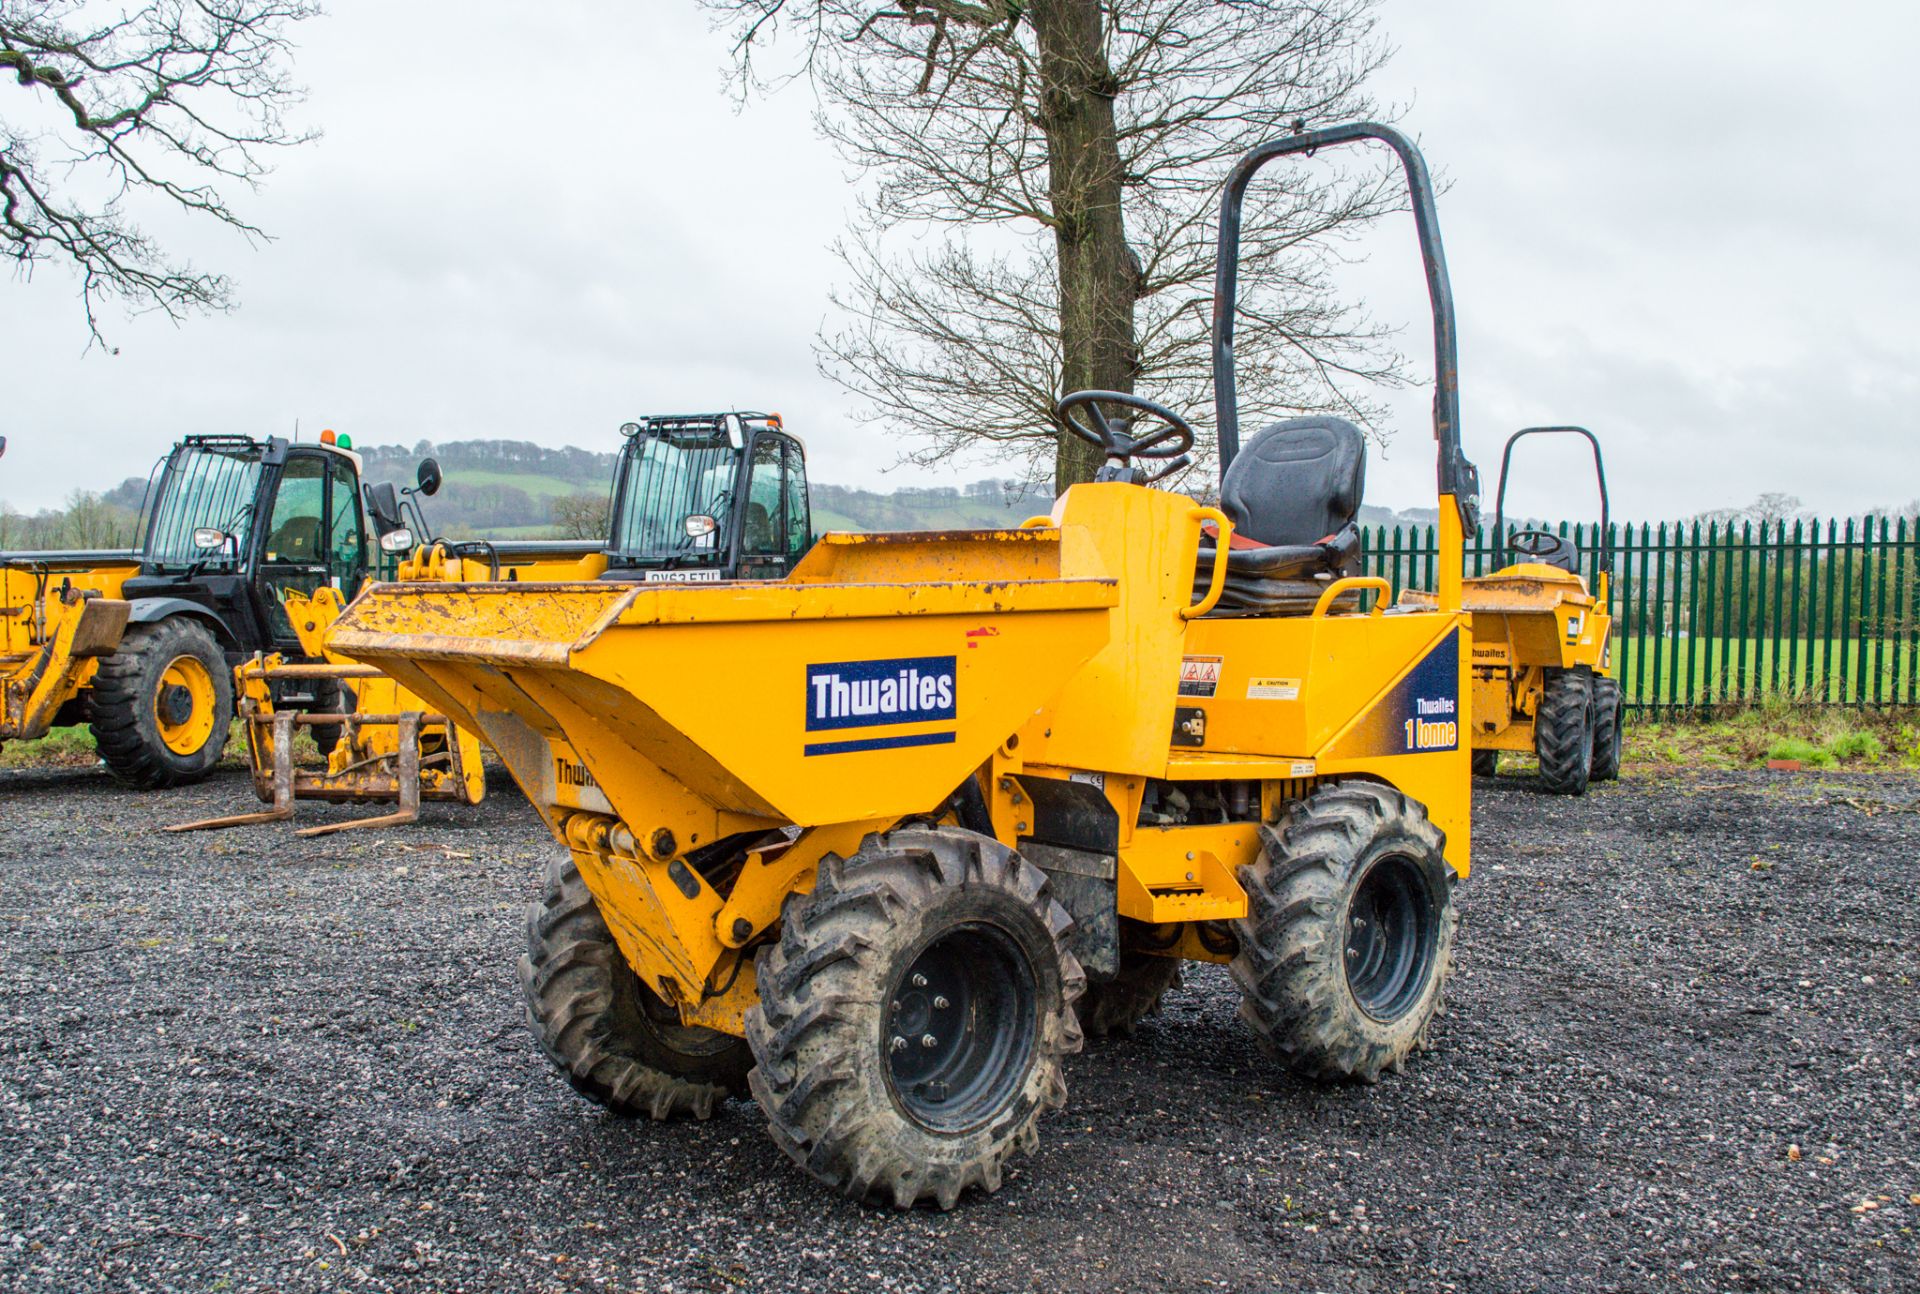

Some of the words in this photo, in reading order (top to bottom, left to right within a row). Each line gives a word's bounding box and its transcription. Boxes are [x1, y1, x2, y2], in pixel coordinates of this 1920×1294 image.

[1472, 648, 1505, 658] hwaites
[812, 669, 953, 718] Thwaites
[1416, 697, 1455, 715] Thwaites
[1405, 718, 1414, 749] 1
[1416, 718, 1457, 748] tonne
